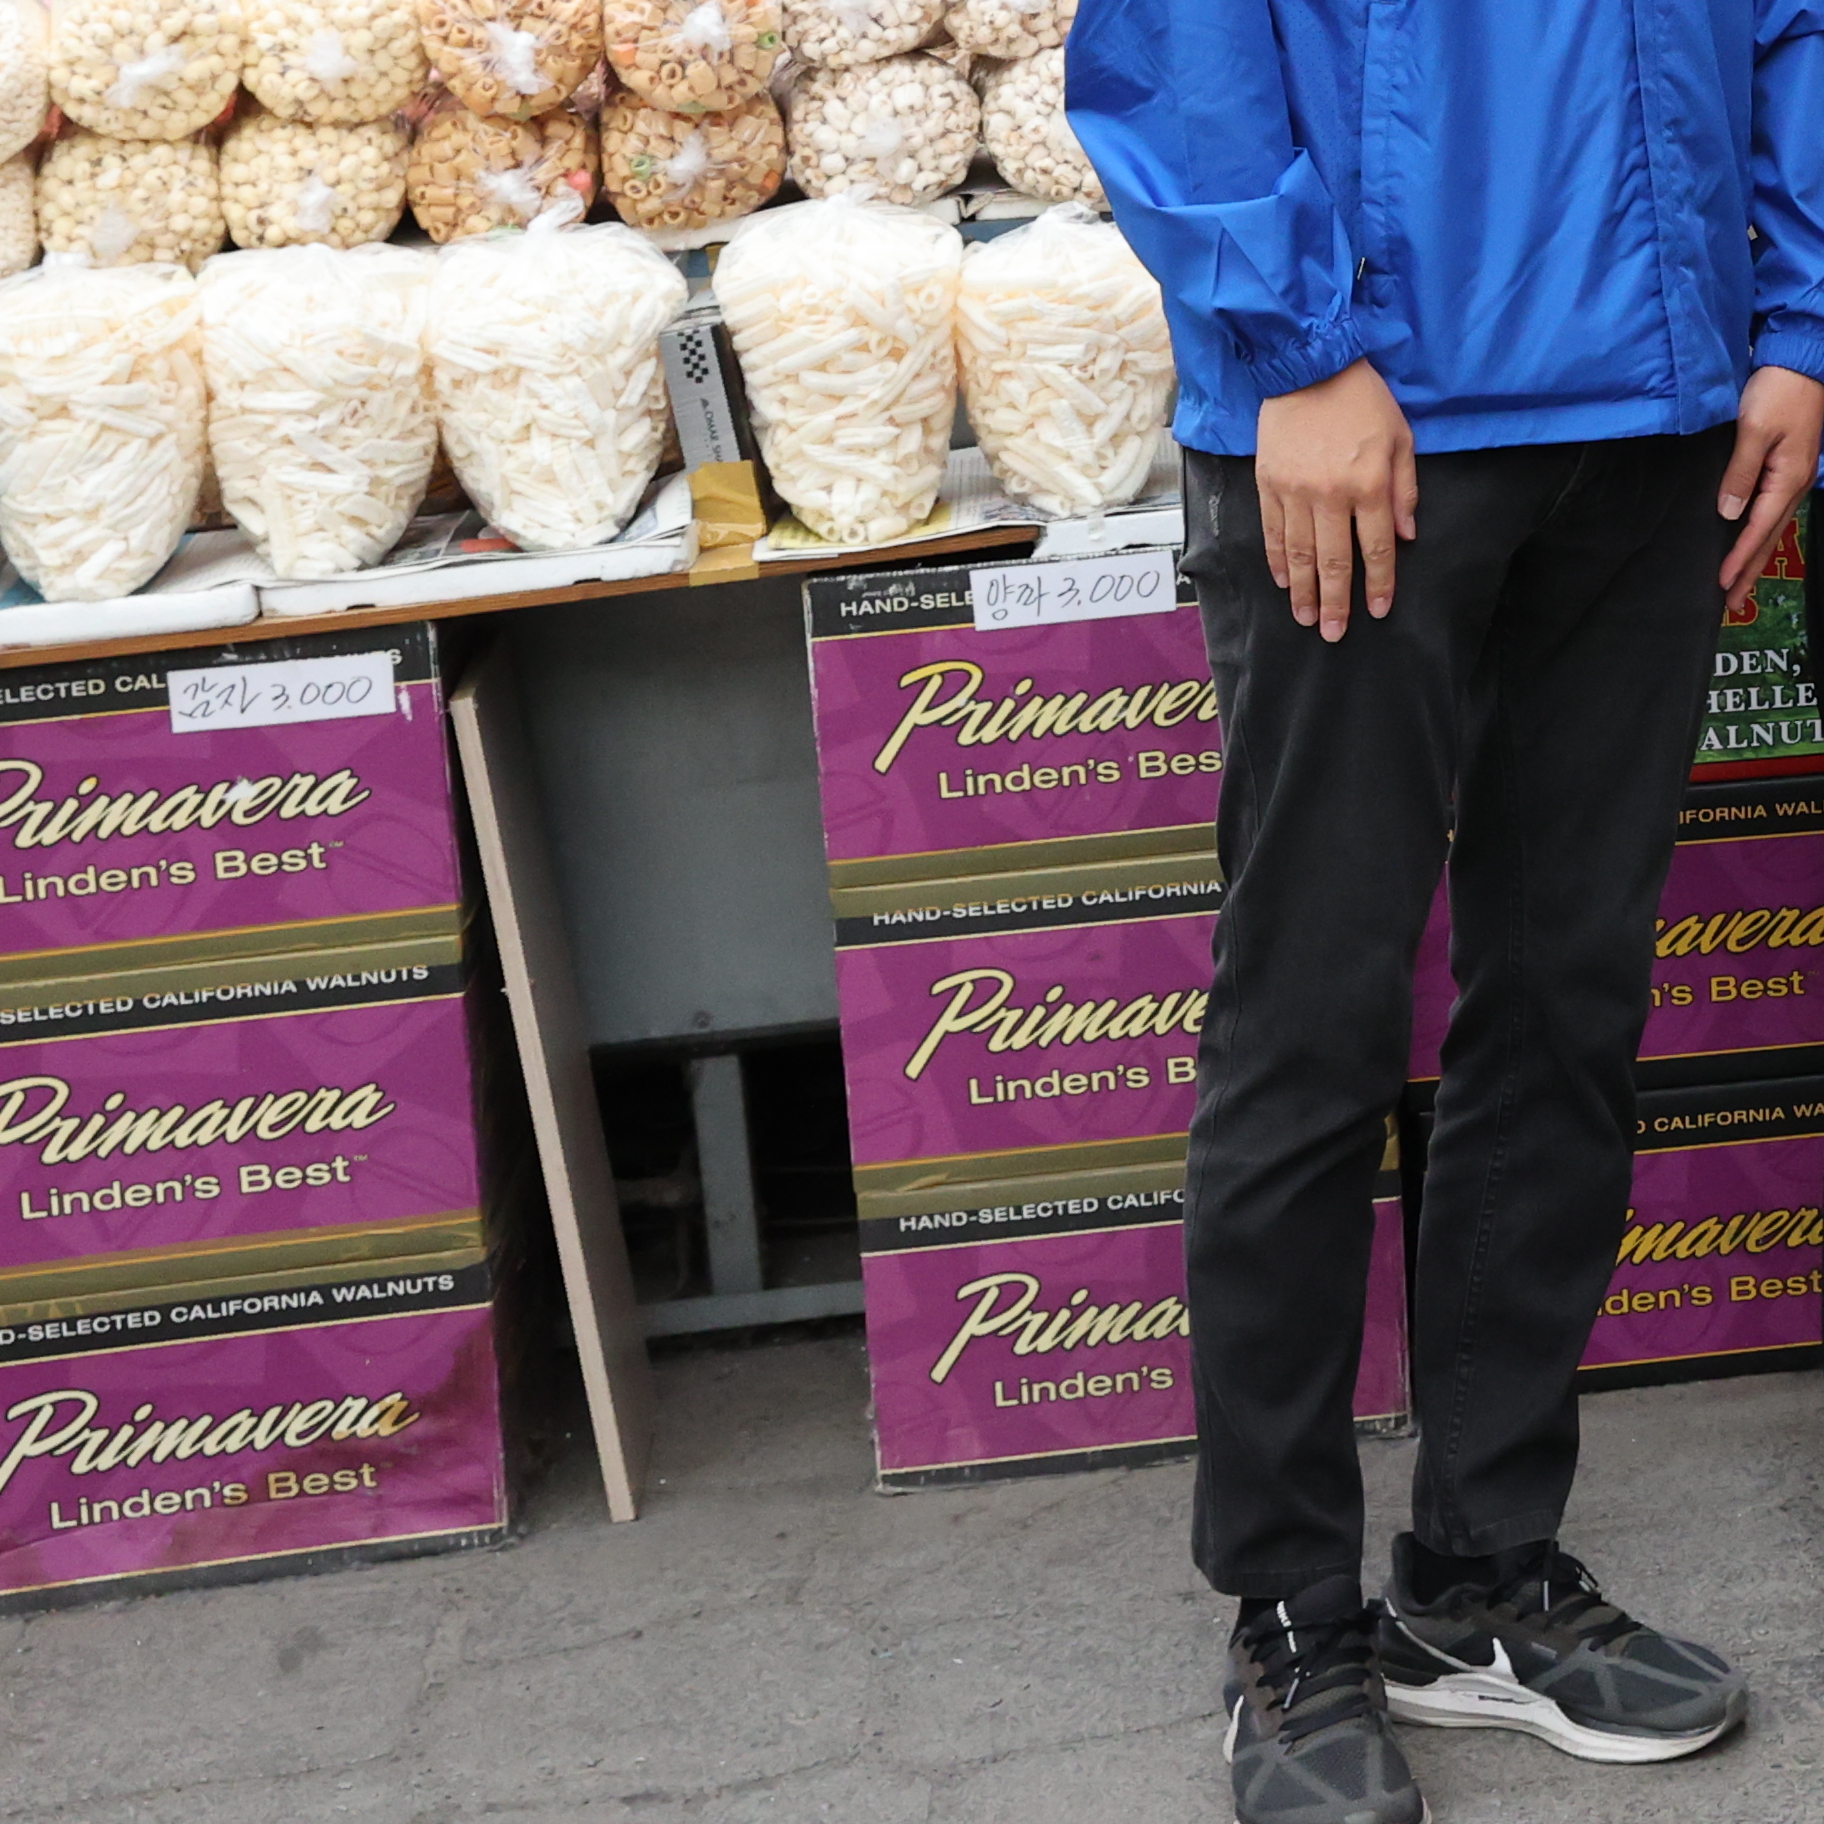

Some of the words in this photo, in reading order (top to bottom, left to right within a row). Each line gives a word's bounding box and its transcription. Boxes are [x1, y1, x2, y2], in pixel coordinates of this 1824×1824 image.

[1055, 569, 1162, 610] 3.000
[270, 675, 374, 713] 3.000
[937, 757, 1122, 800] Linden's
[0, 859, 197, 905] Linden's
[213, 840, 330, 881] Best
[872, 892, 1074, 928] HAND-SELECTED
[1080, 879, 1223, 908] CALIFORNIA
[141, 978, 299, 1011] CALIFORNIA
[304, 964, 431, 993] WALNUTS
[1709, 970, 1806, 1004] Best
[967, 1064, 1151, 1106] Linden's
[0, 1074, 397, 1167] Primavera
[1653, 1105, 1786, 1134] CALIFORNIA
[18, 1173, 222, 1221] Linden's
[237, 1154, 352, 1196] Best
[898, 1196, 1100, 1234] HAND-SELECTED
[1614, 1206, 1824, 1268] maver
[168, 1289, 325, 1326] CALIFORNIA
[330, 1273, 455, 1303] WALNUTS
[1596, 1281, 1714, 1317] den's
[1729, 1268, 1823, 1303] Best
[993, 1364, 1175, 1409] Linden's
[0, 1388, 421, 1495] Primavera
[48, 1480, 250, 1532] Linden's
[266, 1461, 379, 1502] Best
